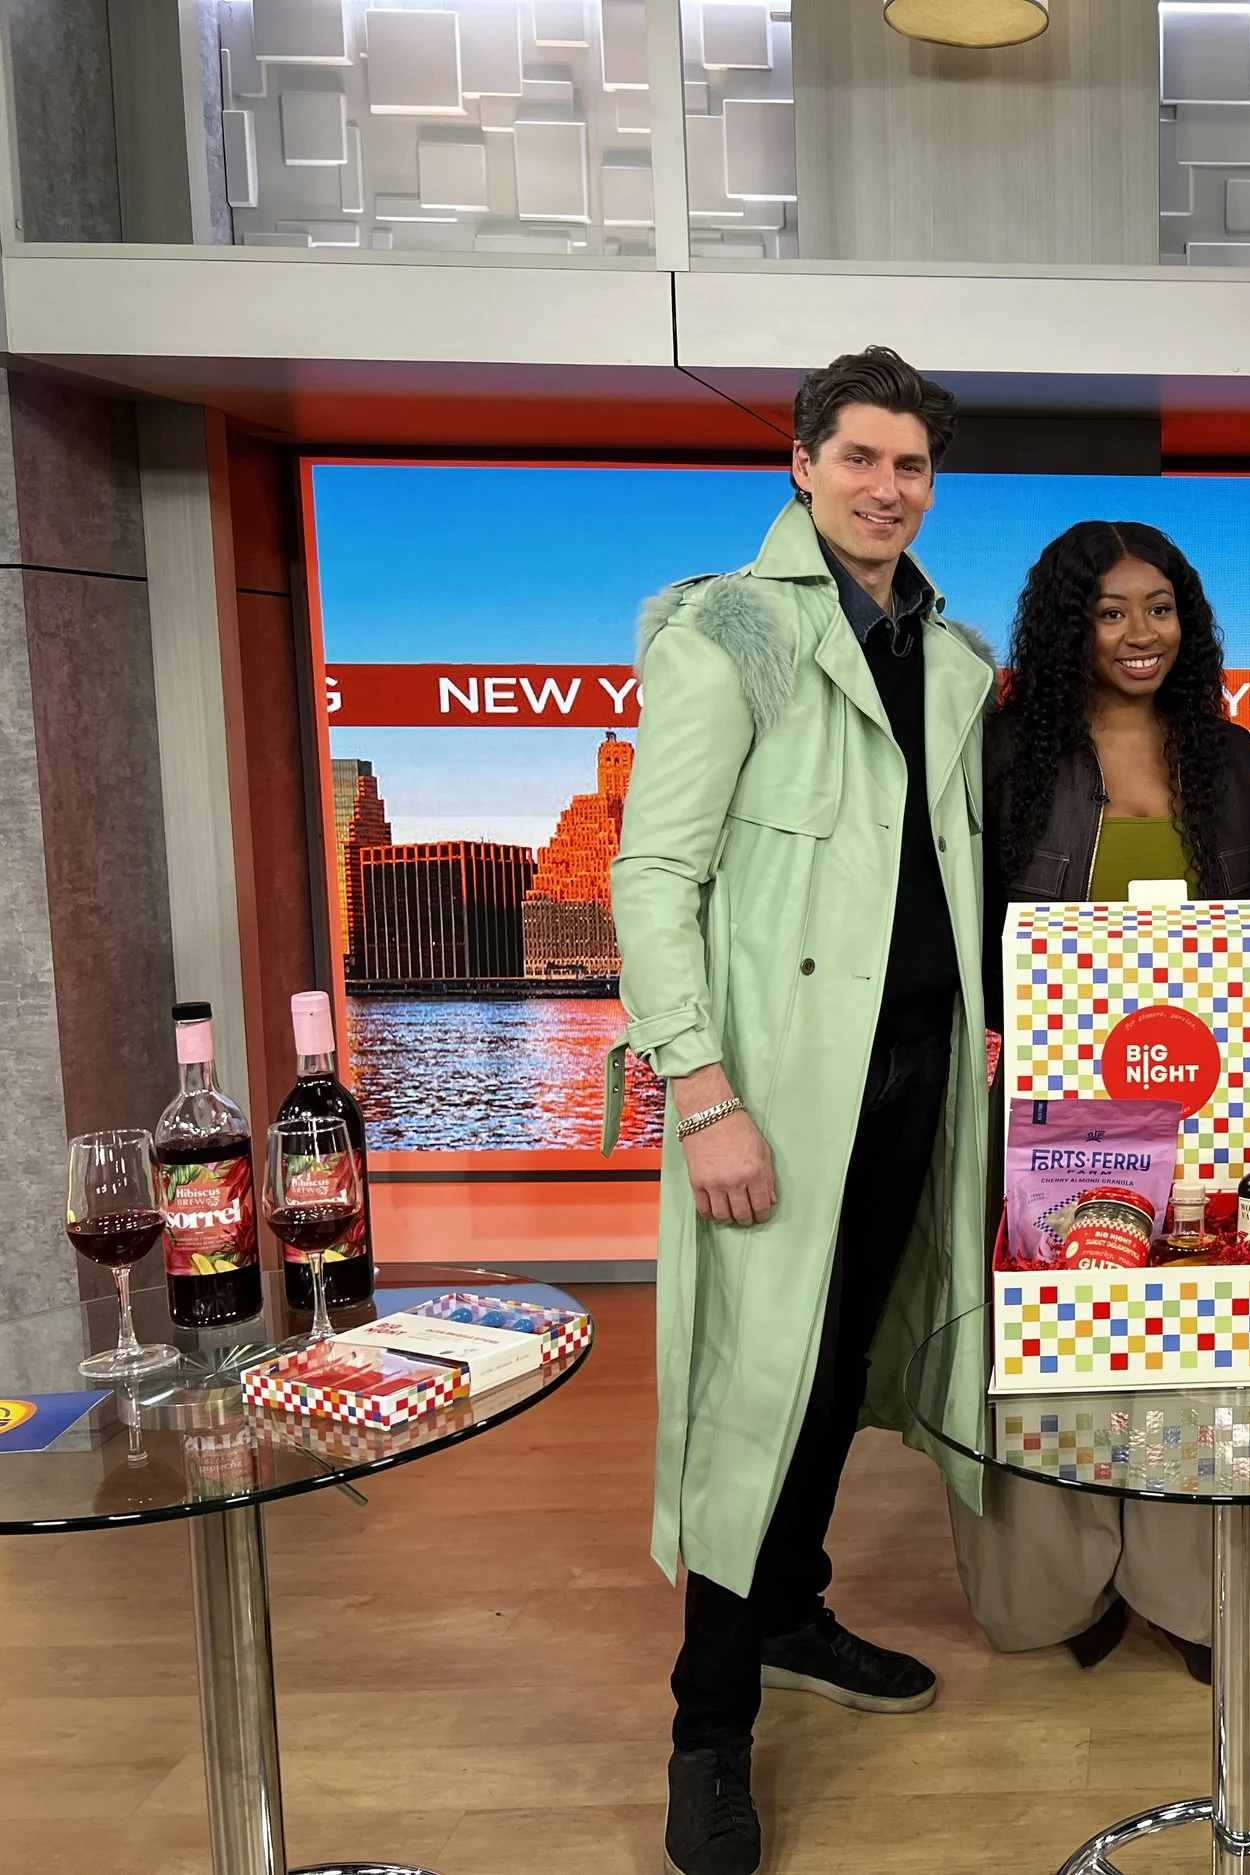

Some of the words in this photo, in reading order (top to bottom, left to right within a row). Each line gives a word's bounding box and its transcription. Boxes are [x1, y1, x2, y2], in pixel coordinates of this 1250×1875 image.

[438, 676, 582, 714] NEW
[1101, 1178, 1134, 1187] GRANOLA
[176, 1187, 221, 1199] Hibiscus
[177, 1198, 206, 1207] BREW
[166, 1197, 242, 1230] sorrel
